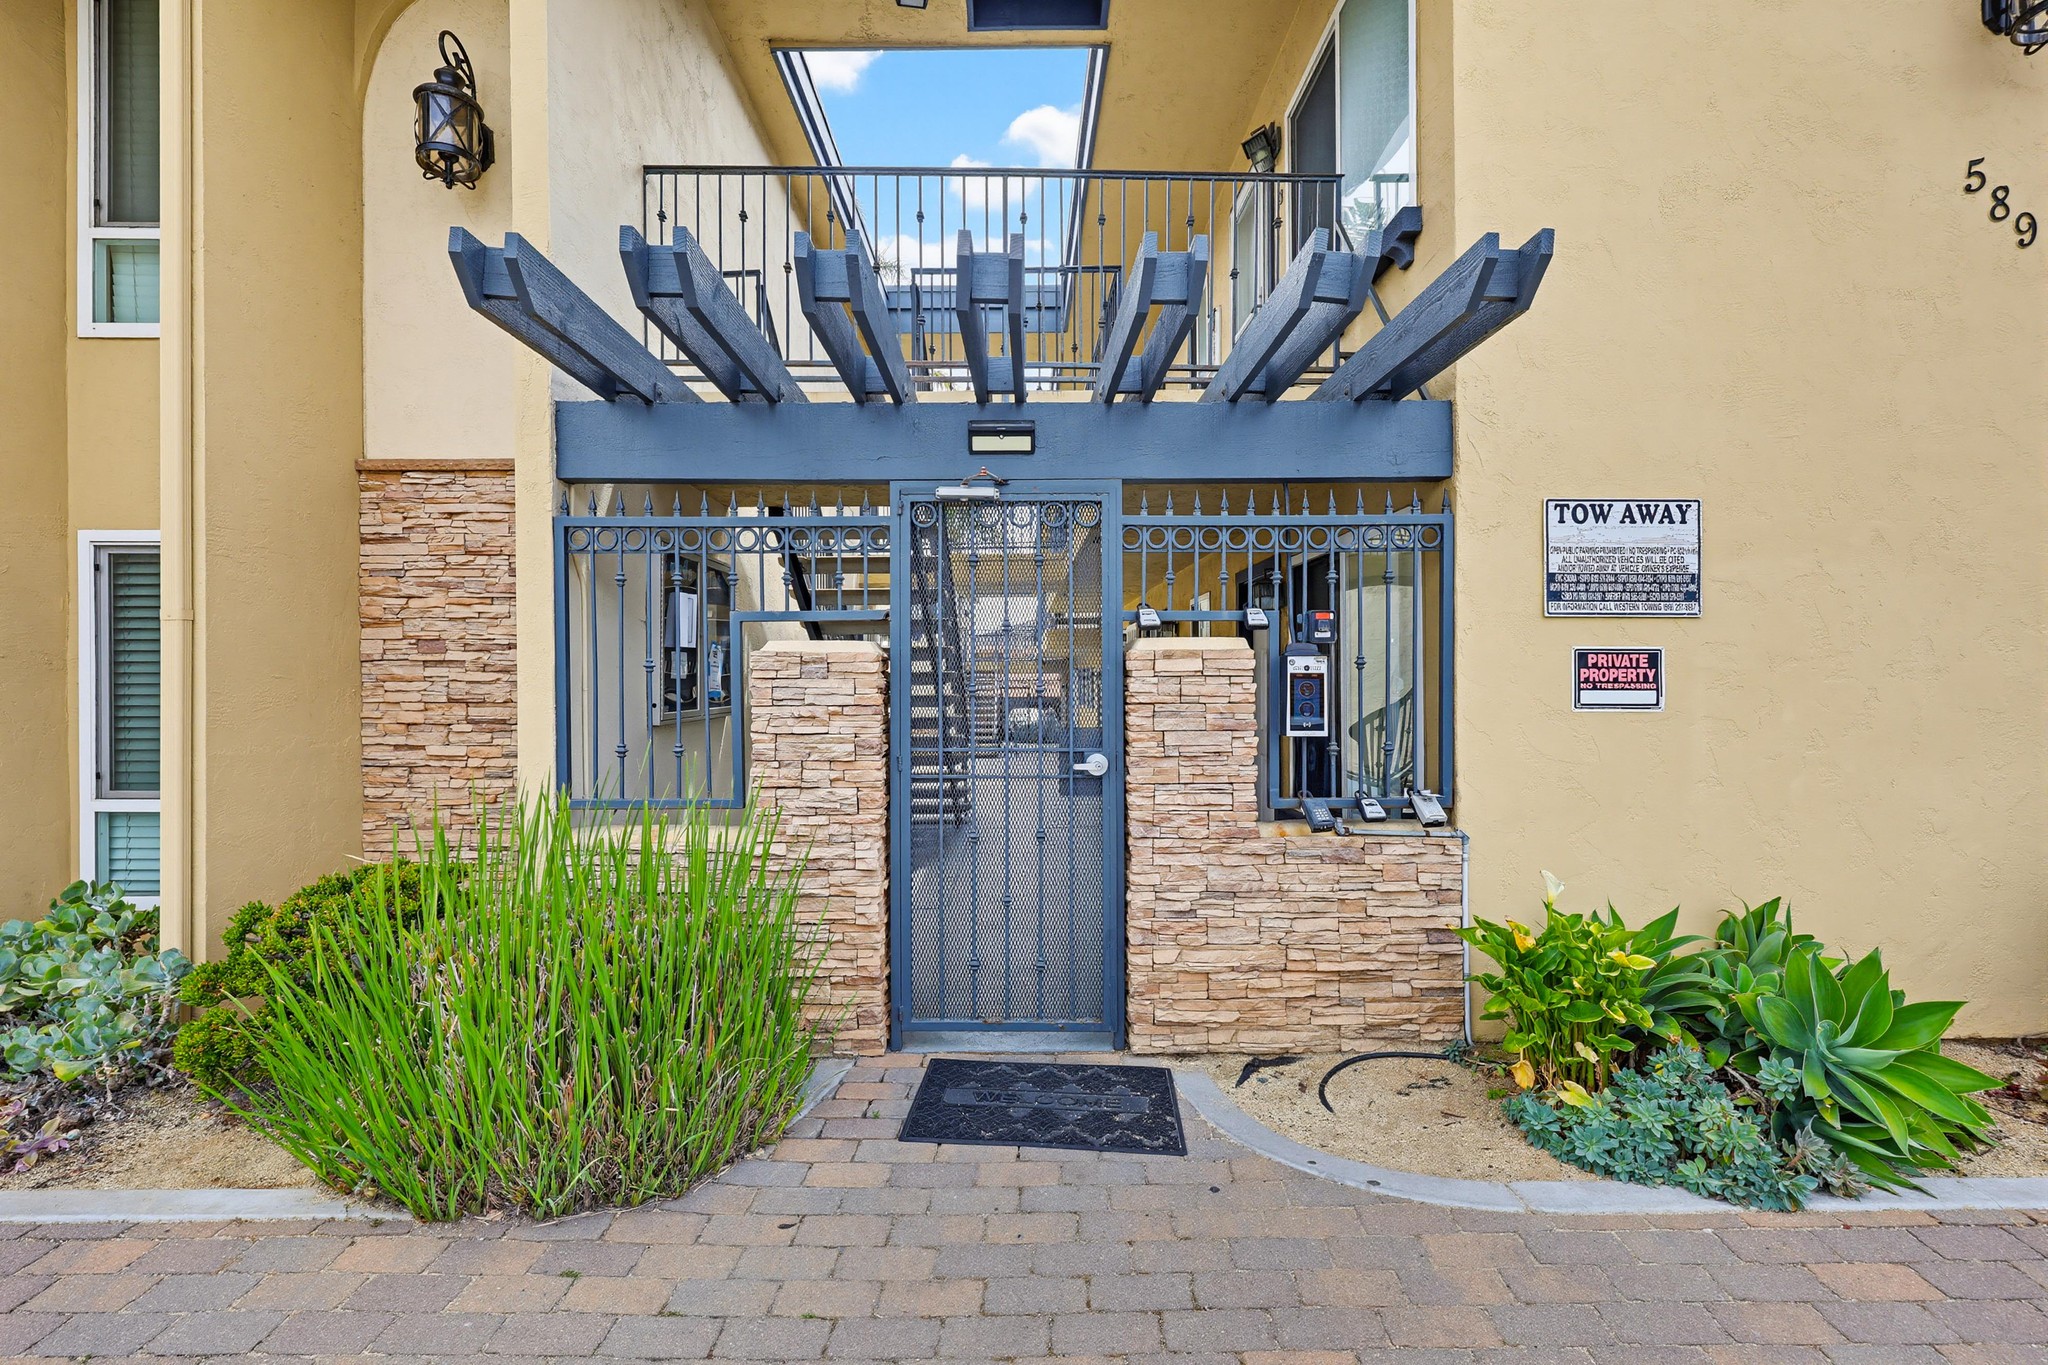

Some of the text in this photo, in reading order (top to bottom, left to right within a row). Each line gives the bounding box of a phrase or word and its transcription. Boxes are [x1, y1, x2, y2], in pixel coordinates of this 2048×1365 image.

[1964, 157, 2038, 248] 589
[1554, 503, 1692, 524] TOW AWAY
[1561, 555, 1685, 564] ALL UNAUTHORIZED VEHICLES WILL BE CITED
[1577, 564, 1595, 572] TOWED
[1618, 564, 1640, 572] VEHICLE
[1666, 564, 1690, 572] EXPENSE
[1550, 602, 1561, 611] FOR
[1562, 602, 1598, 611] INFORMATION
[1599, 602, 1613, 611] CALL
[1614, 602, 1640, 611] WESTERN
[1641, 602, 1663, 611] TOWING
[1587, 654, 1649, 667] PRIVATE
[1580, 668, 1656, 682] PROPERTY
